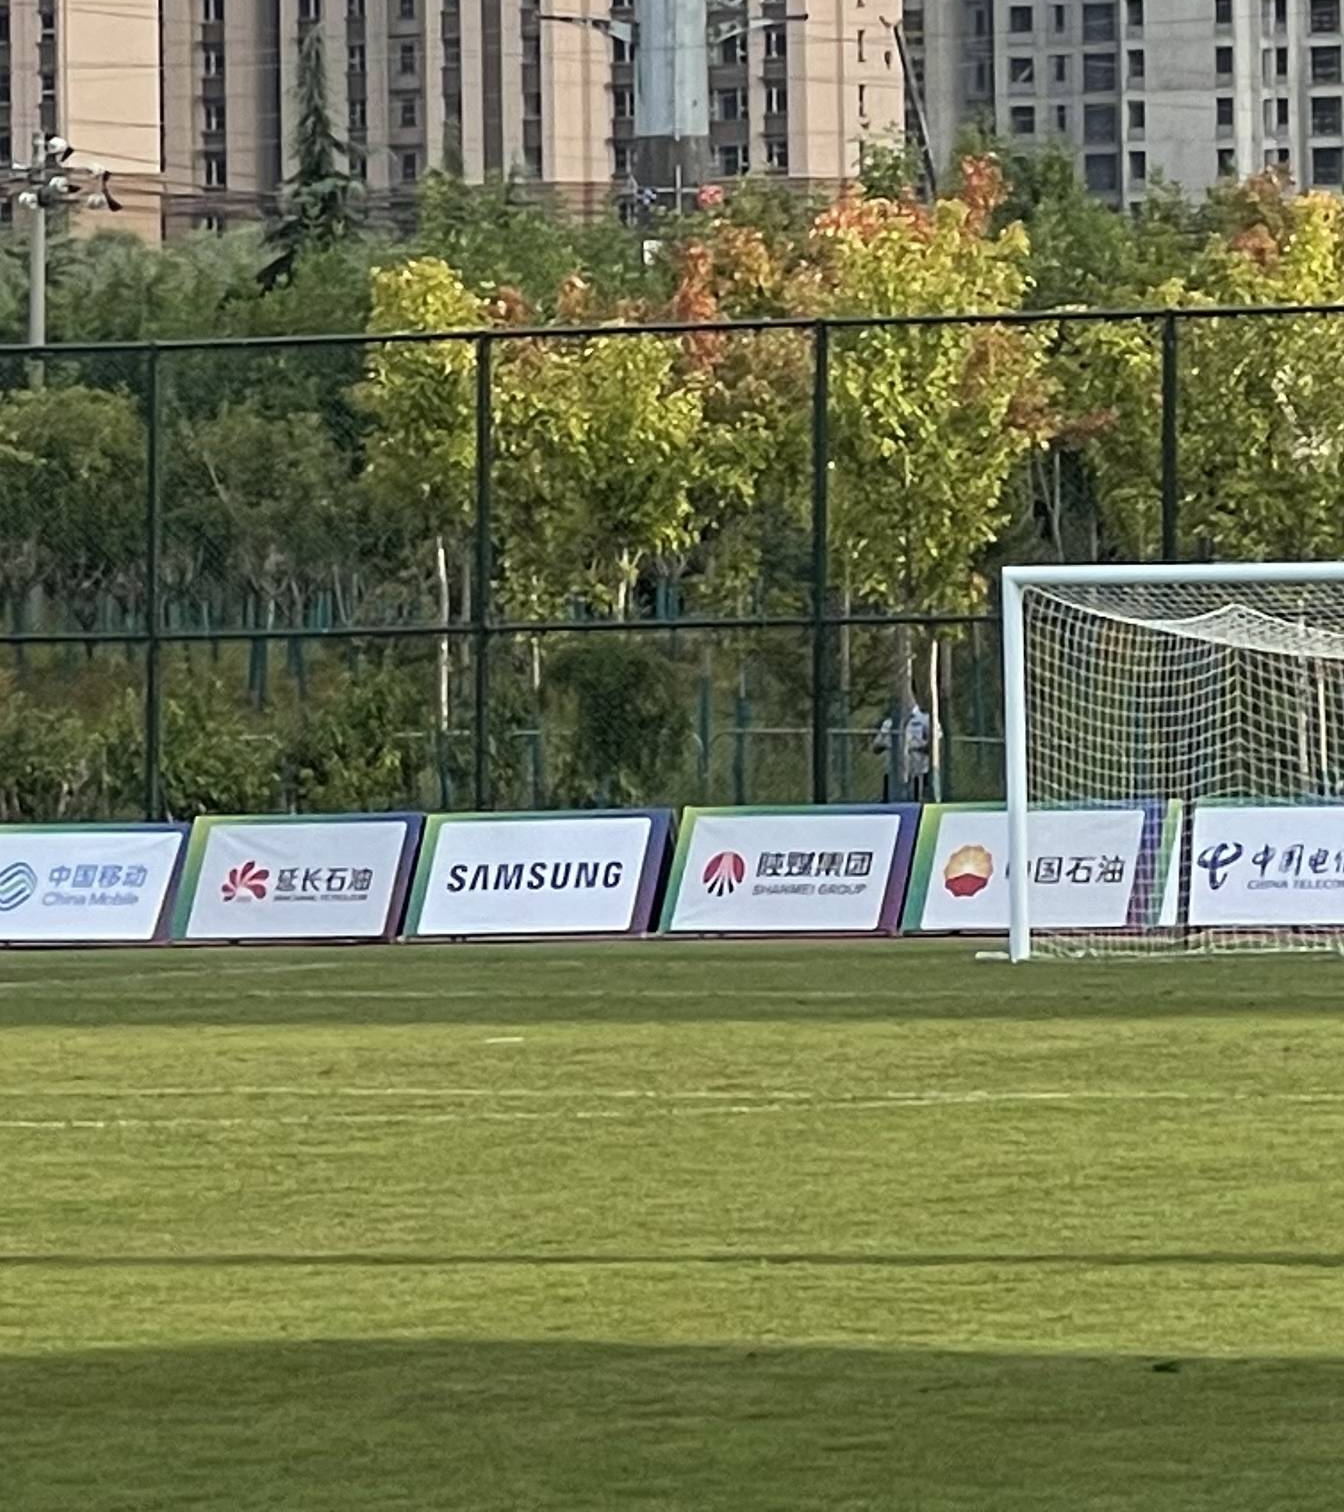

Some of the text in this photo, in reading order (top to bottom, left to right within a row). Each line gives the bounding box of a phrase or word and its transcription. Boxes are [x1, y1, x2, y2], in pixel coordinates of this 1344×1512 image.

[49, 864, 148, 888] 中国移动
[274, 867, 373, 892] 延长石油
[446, 861, 623, 892] SAMSUNG
